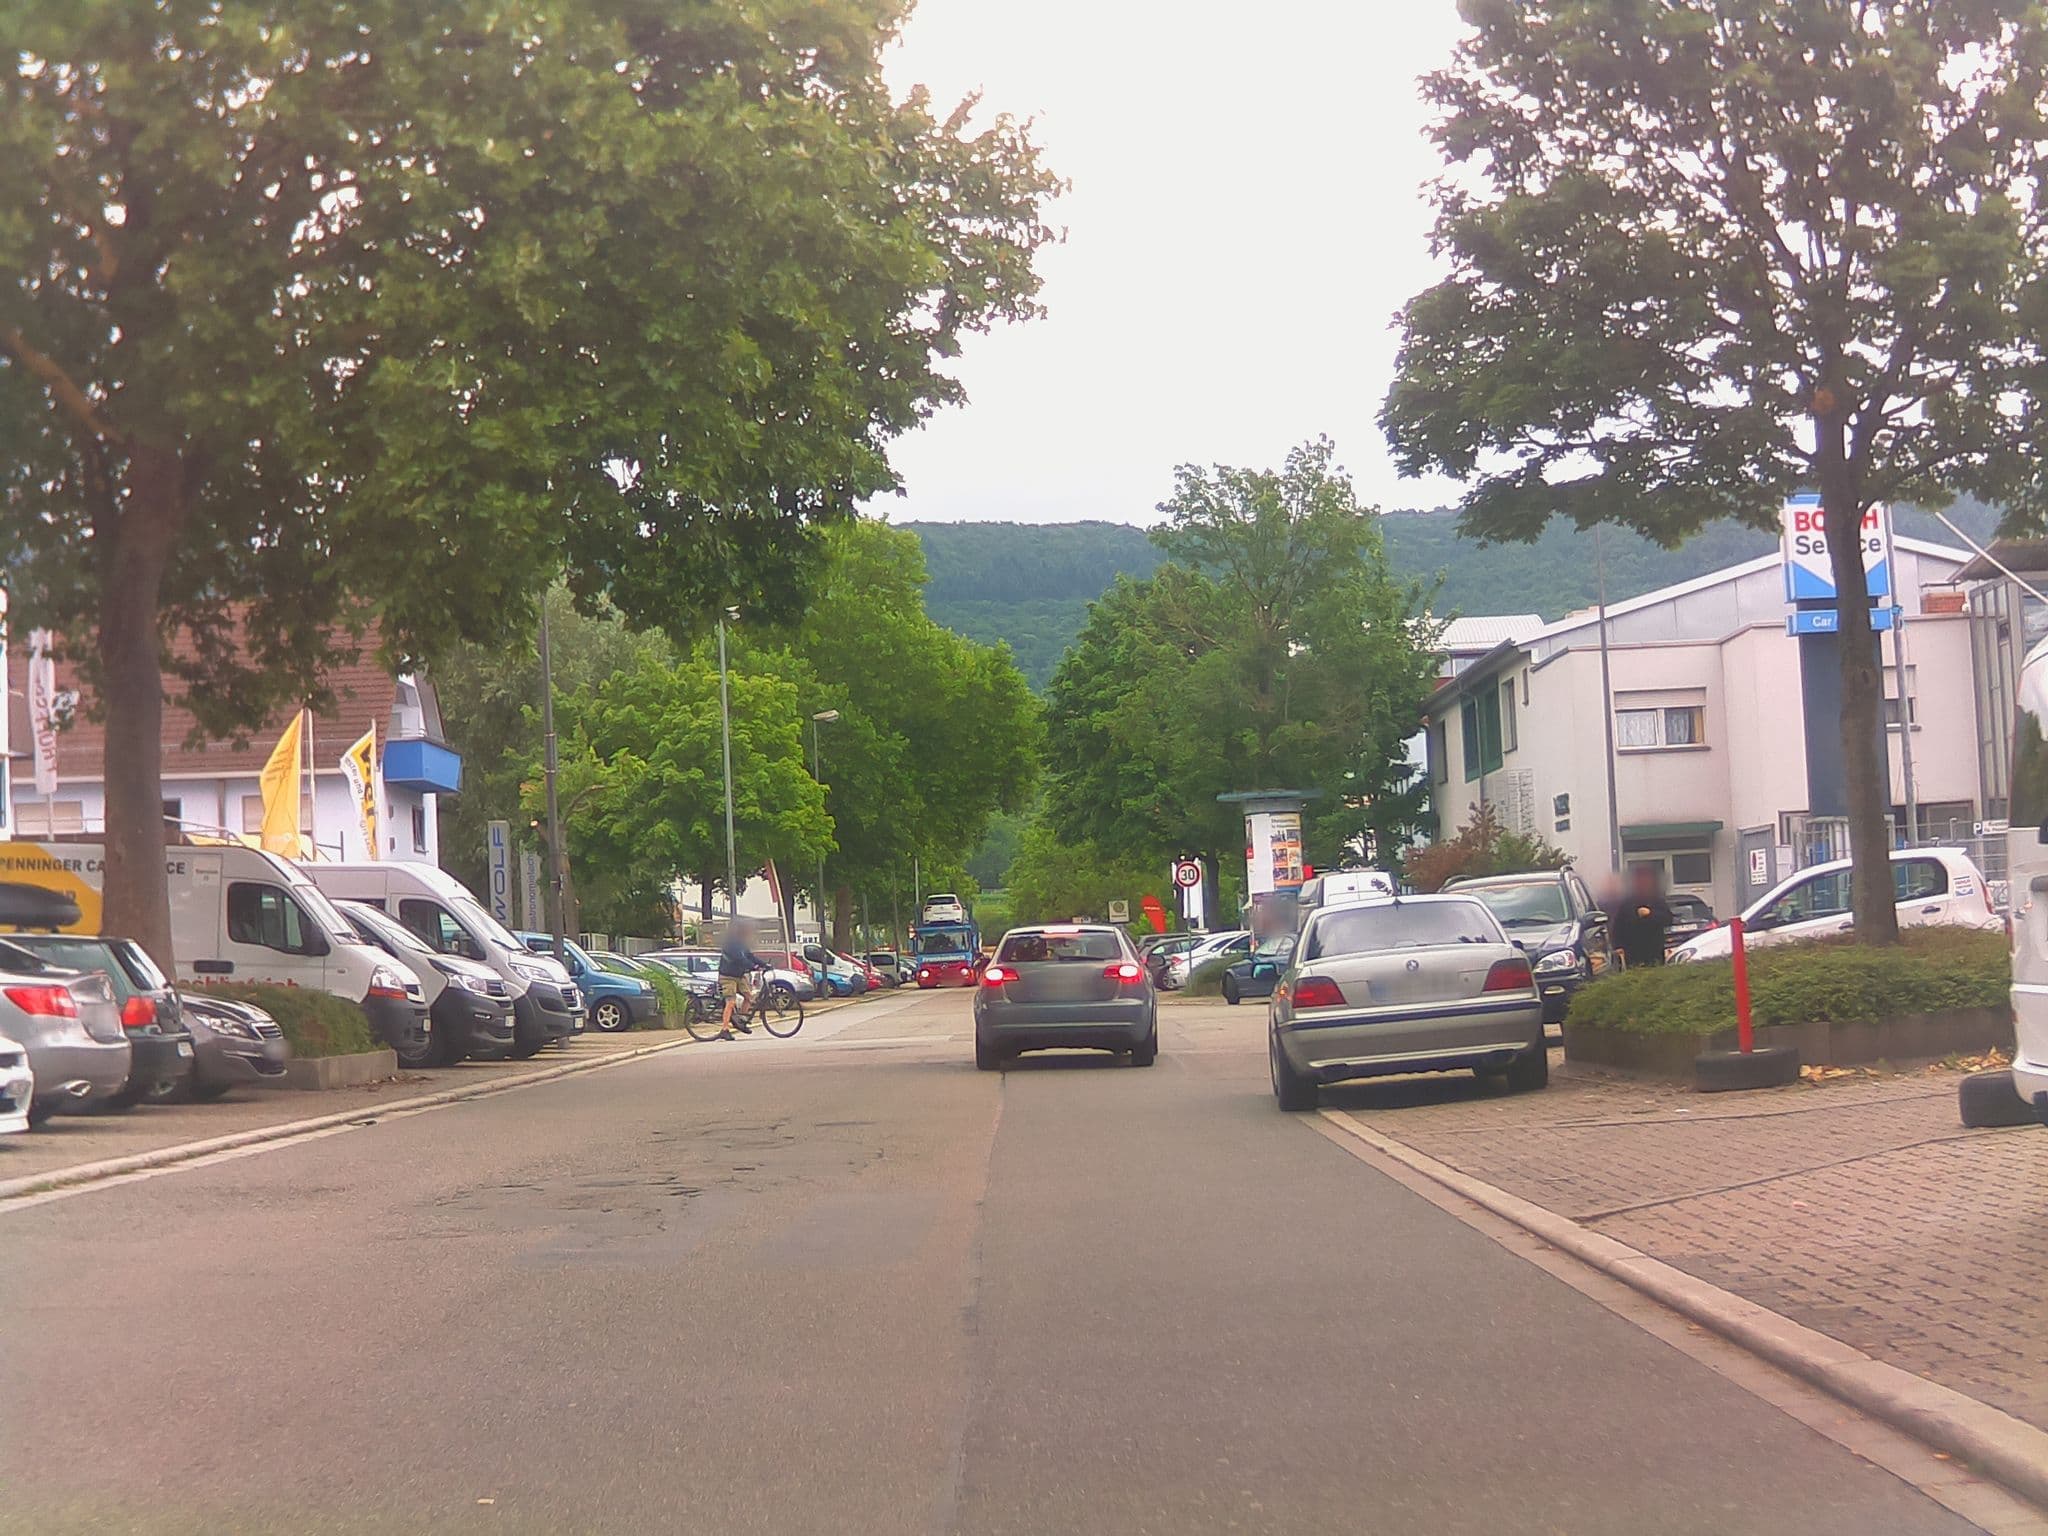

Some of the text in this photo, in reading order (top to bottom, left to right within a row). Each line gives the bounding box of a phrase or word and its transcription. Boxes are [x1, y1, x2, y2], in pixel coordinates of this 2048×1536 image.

[1795, 508, 1879, 532] BOH
[1796, 534, 1882, 555] Sece
[1812, 615, 1833, 628] Car
[493, 827, 506, 921] WOLF
[1181, 868, 1195, 881] 30
